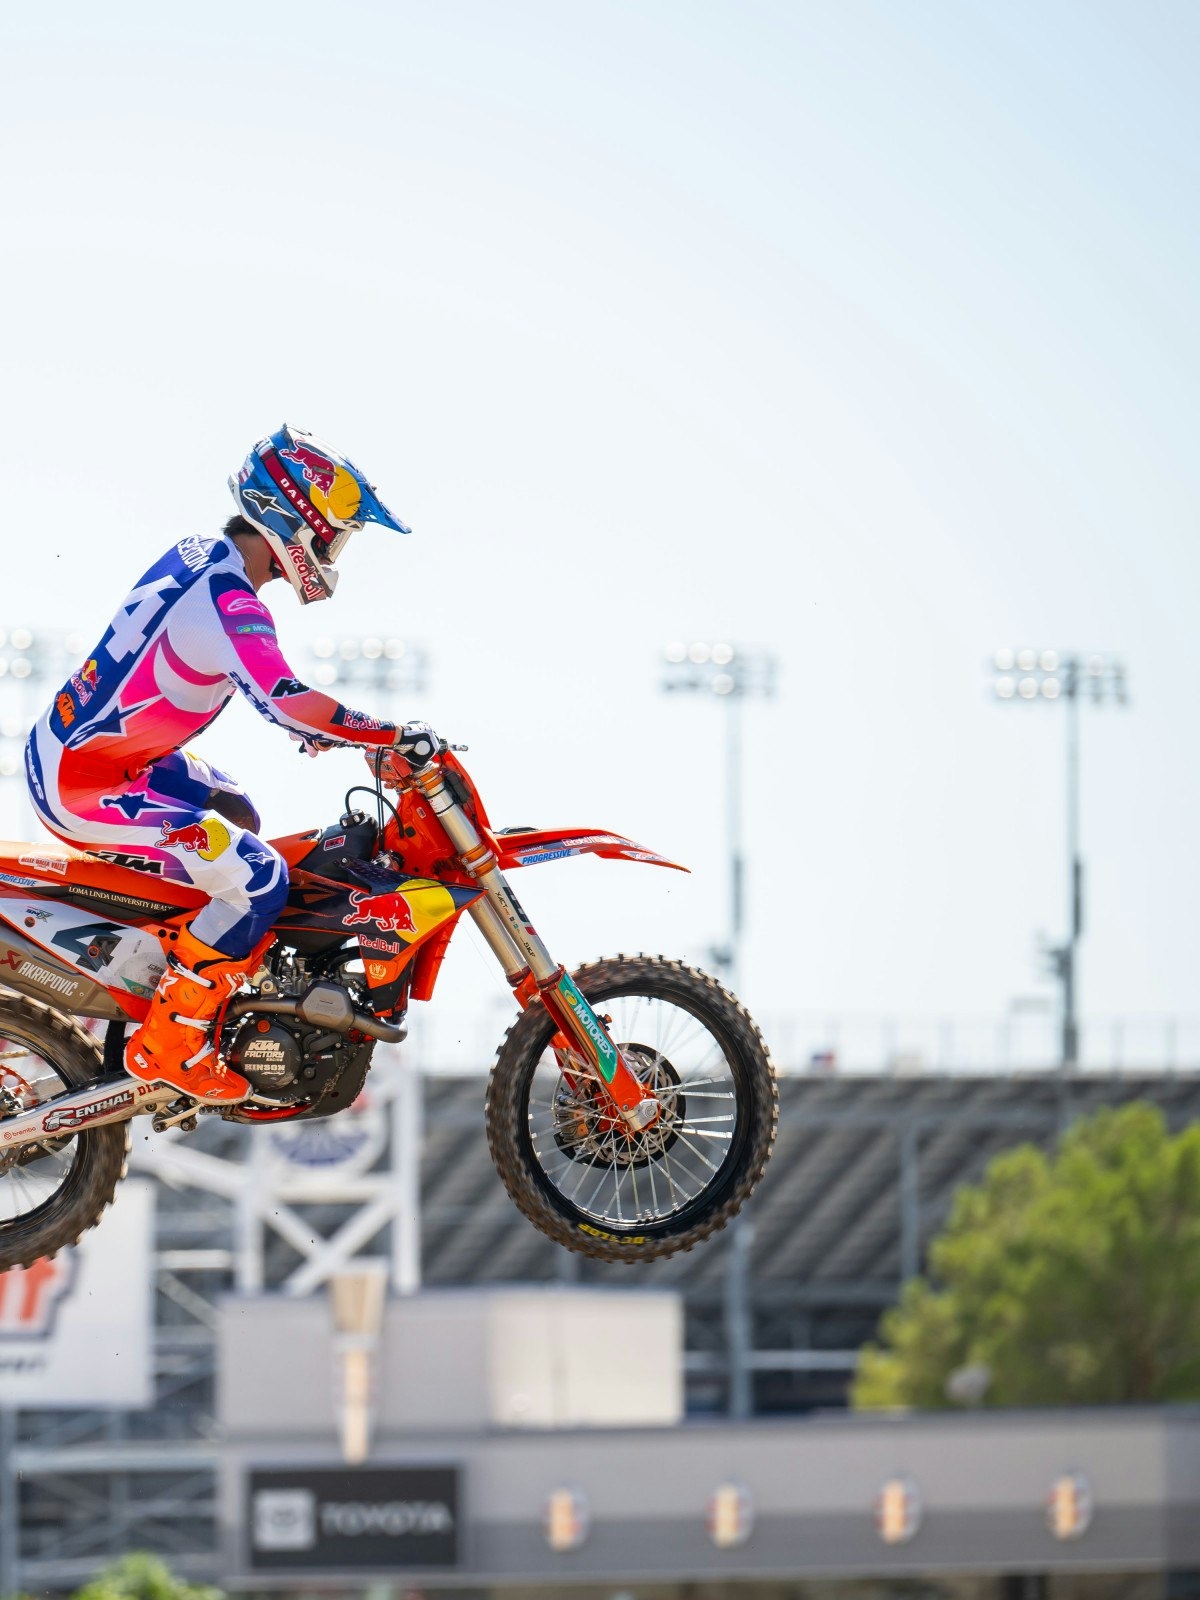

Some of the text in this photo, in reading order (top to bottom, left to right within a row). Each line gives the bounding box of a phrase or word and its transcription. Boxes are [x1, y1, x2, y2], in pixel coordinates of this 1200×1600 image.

[280, 478, 329, 534] OAKLEY
[177, 535, 209, 573] SEXTON
[105, 574, 182, 664] 4
[57, 692, 76, 729] KTM
[85, 851, 162, 875] KTM
[522, 849, 572, 864] PROGRESSIVE
[68, 886, 89, 896] LOMA
[89, 889, 110, 900] LINDA
[111, 893, 150, 908] UNIVERSITY
[51, 922, 128, 973] 4
[360, 934, 400, 954] Red Bull
[18, 961, 79, 997] AKRAPOVIČ
[247, 1040, 281, 1051] KTM
[574, 1003, 614, 1059] MOTOREX
[244, 1050, 285, 1058] FACTORY
[44, 1091, 133, 1132] RENTHAL
[12, 1126, 37, 1137] brembo
[321, 1502, 453, 1536] TOYOTA
